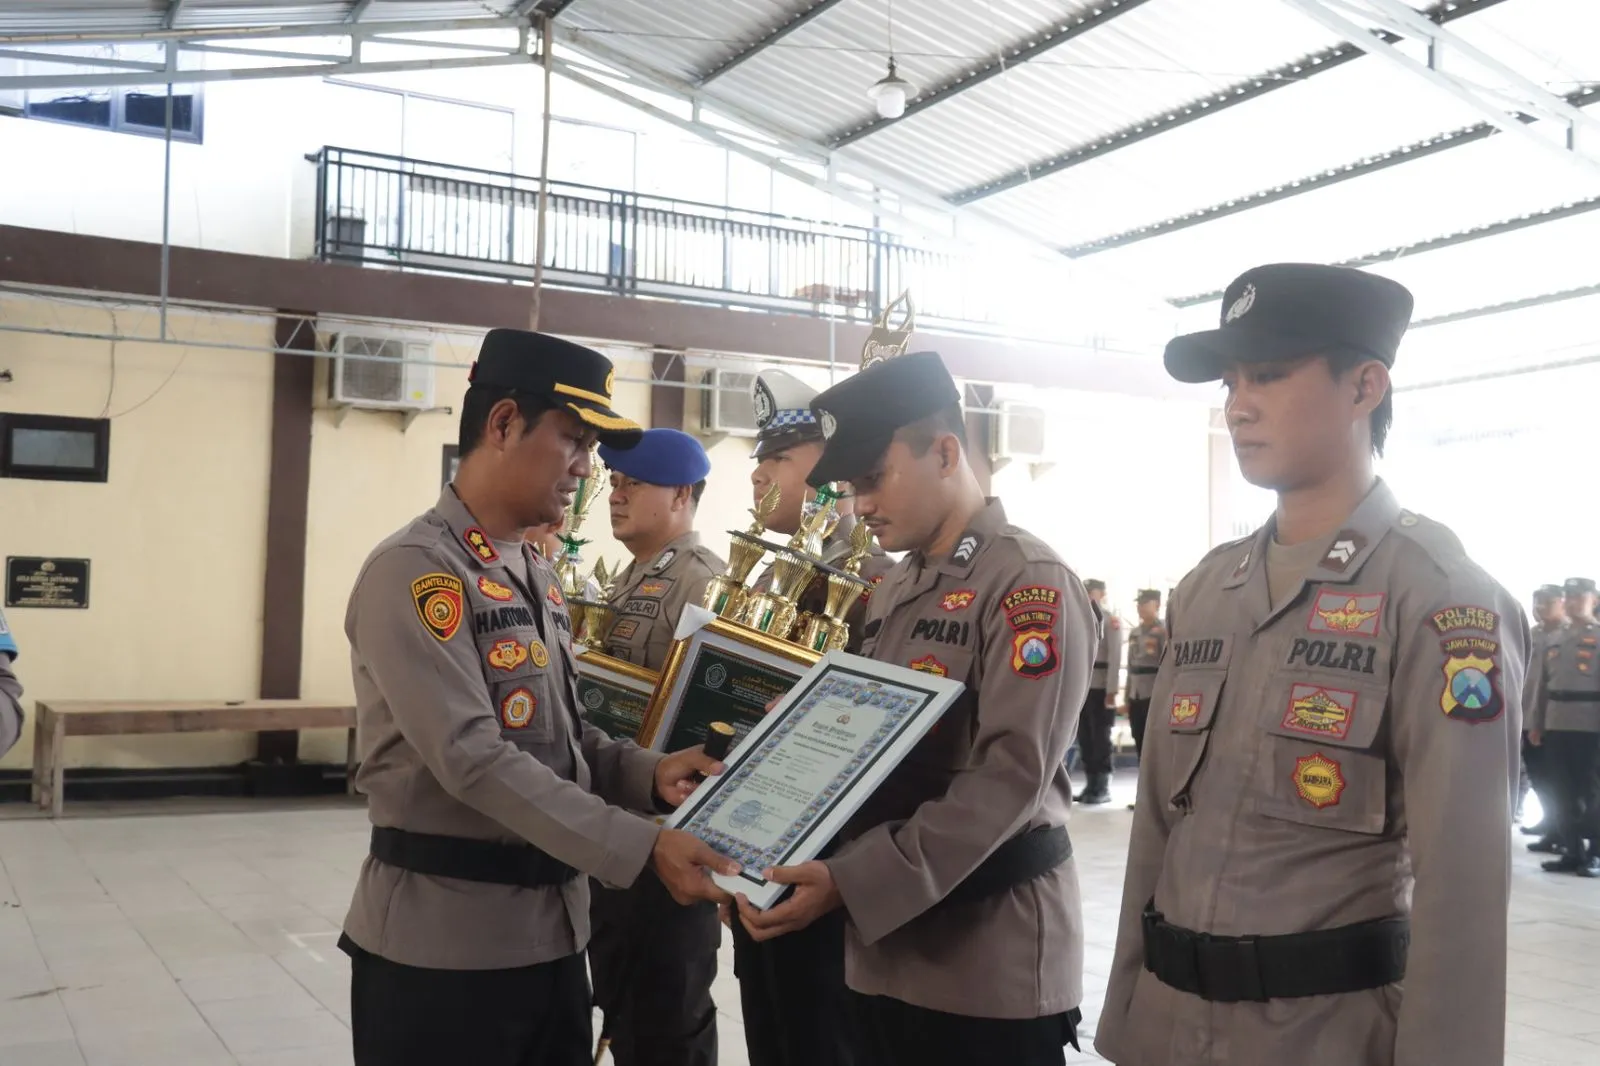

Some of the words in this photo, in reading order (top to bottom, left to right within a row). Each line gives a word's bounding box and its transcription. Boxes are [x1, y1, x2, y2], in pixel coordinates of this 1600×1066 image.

[415, 579, 460, 595] BAINTELKAM
[1005, 588, 1056, 605] POLRES
[1007, 595, 1054, 609] SAMPANG
[624, 600, 657, 615] POLRI
[1433, 607, 1494, 622] POLRES
[1013, 612, 1031, 625] JAWA
[1437, 617, 1493, 632] SAMPANG
[911, 618, 969, 646] POLRI
[1174, 639, 1223, 666] ZAHID
[1445, 638, 1469, 651] JAWA
[1469, 638, 1496, 652] TIMUR
[1287, 638, 1375, 674] POLRI
